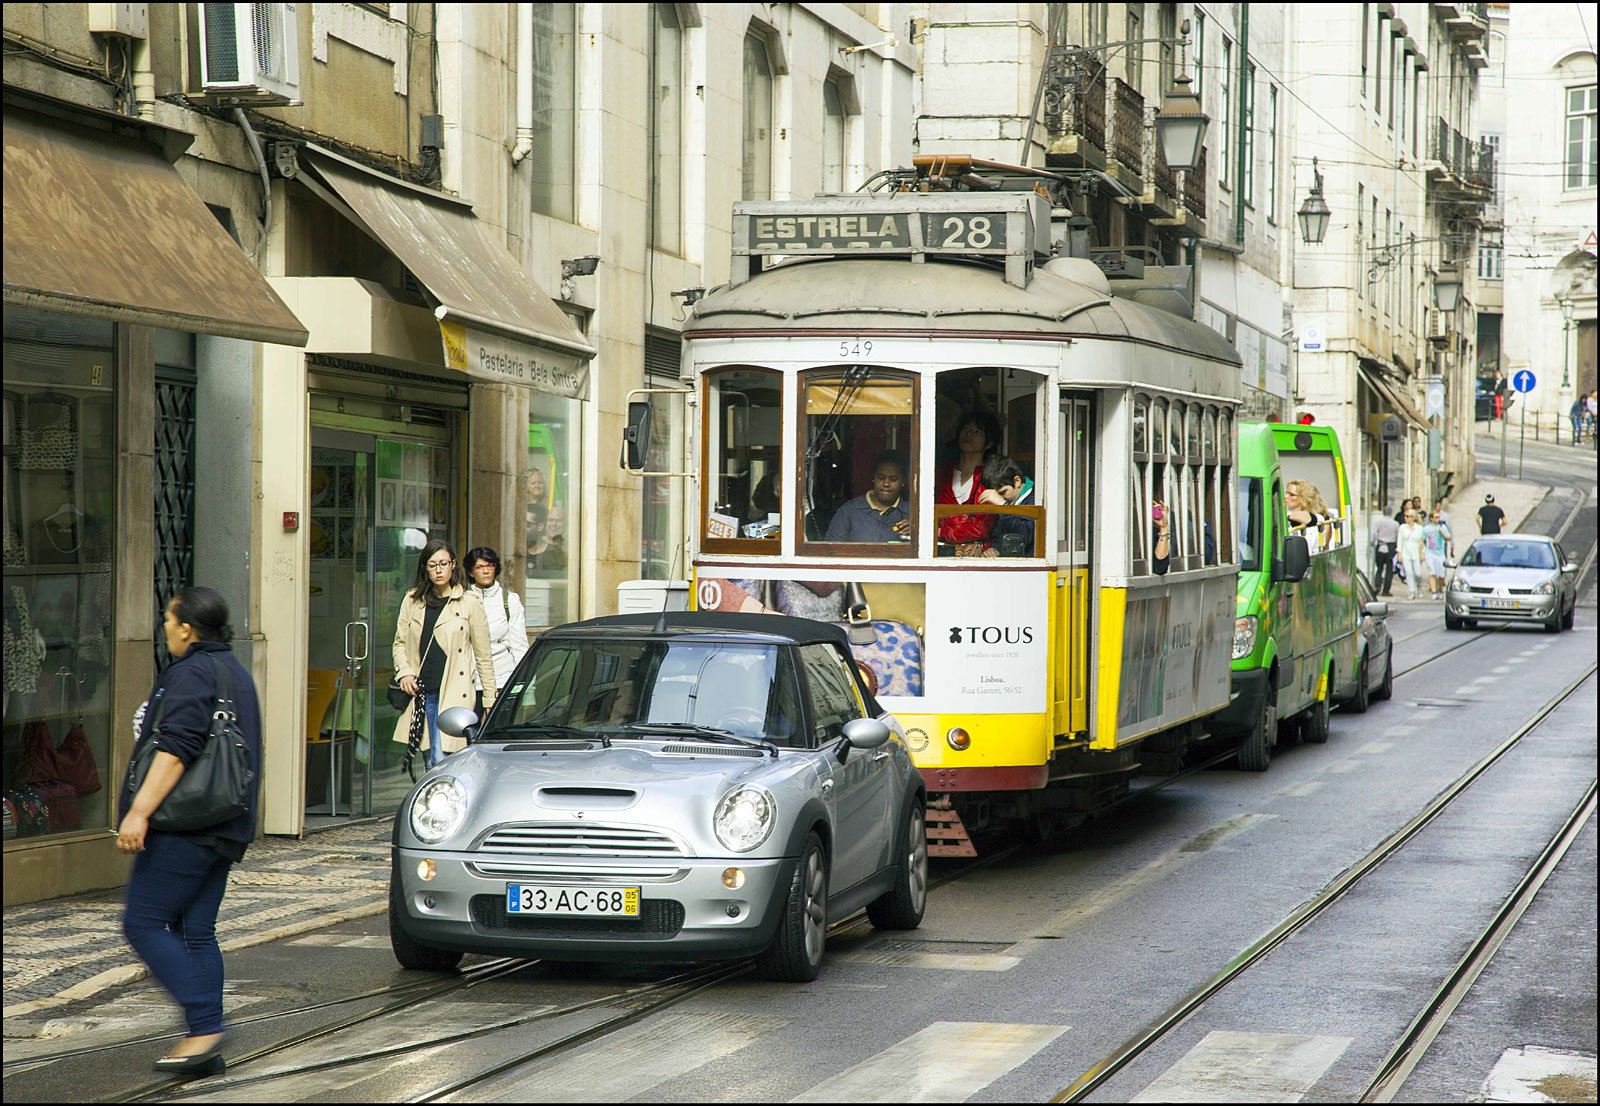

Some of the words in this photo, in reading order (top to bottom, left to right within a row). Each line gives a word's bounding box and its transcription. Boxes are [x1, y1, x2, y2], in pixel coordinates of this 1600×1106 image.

[756, 216, 899, 239] ESTRELA
[943, 216, 992, 248] 28
[840, 340, 873, 357] 549
[479, 347, 523, 377] Pastelaria
[966, 626, 1033, 644] TOUS
[1003, 686, 1022, 694] 50-52
[625, 891, 636, 899] 05
[625, 904, 636, 912] 06
